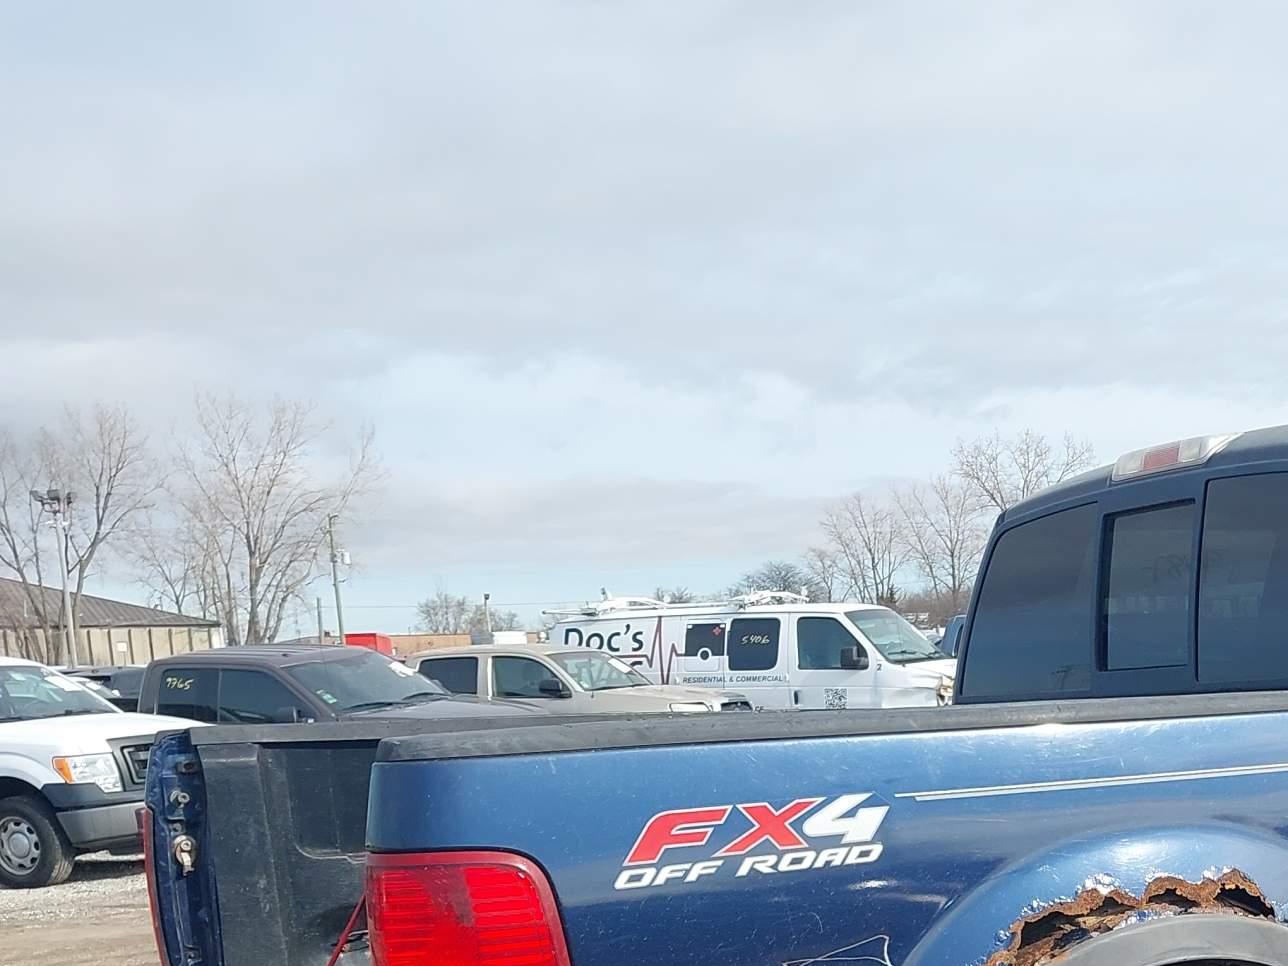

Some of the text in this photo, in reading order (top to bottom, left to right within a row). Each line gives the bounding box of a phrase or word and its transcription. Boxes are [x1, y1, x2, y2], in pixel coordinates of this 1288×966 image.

[682, 676, 727, 684] RESIDENTIAL
[736, 675, 783, 683] COMMERCIAL
[622, 791, 890, 867] FX4
[613, 843, 884, 890] OFF ROAD
